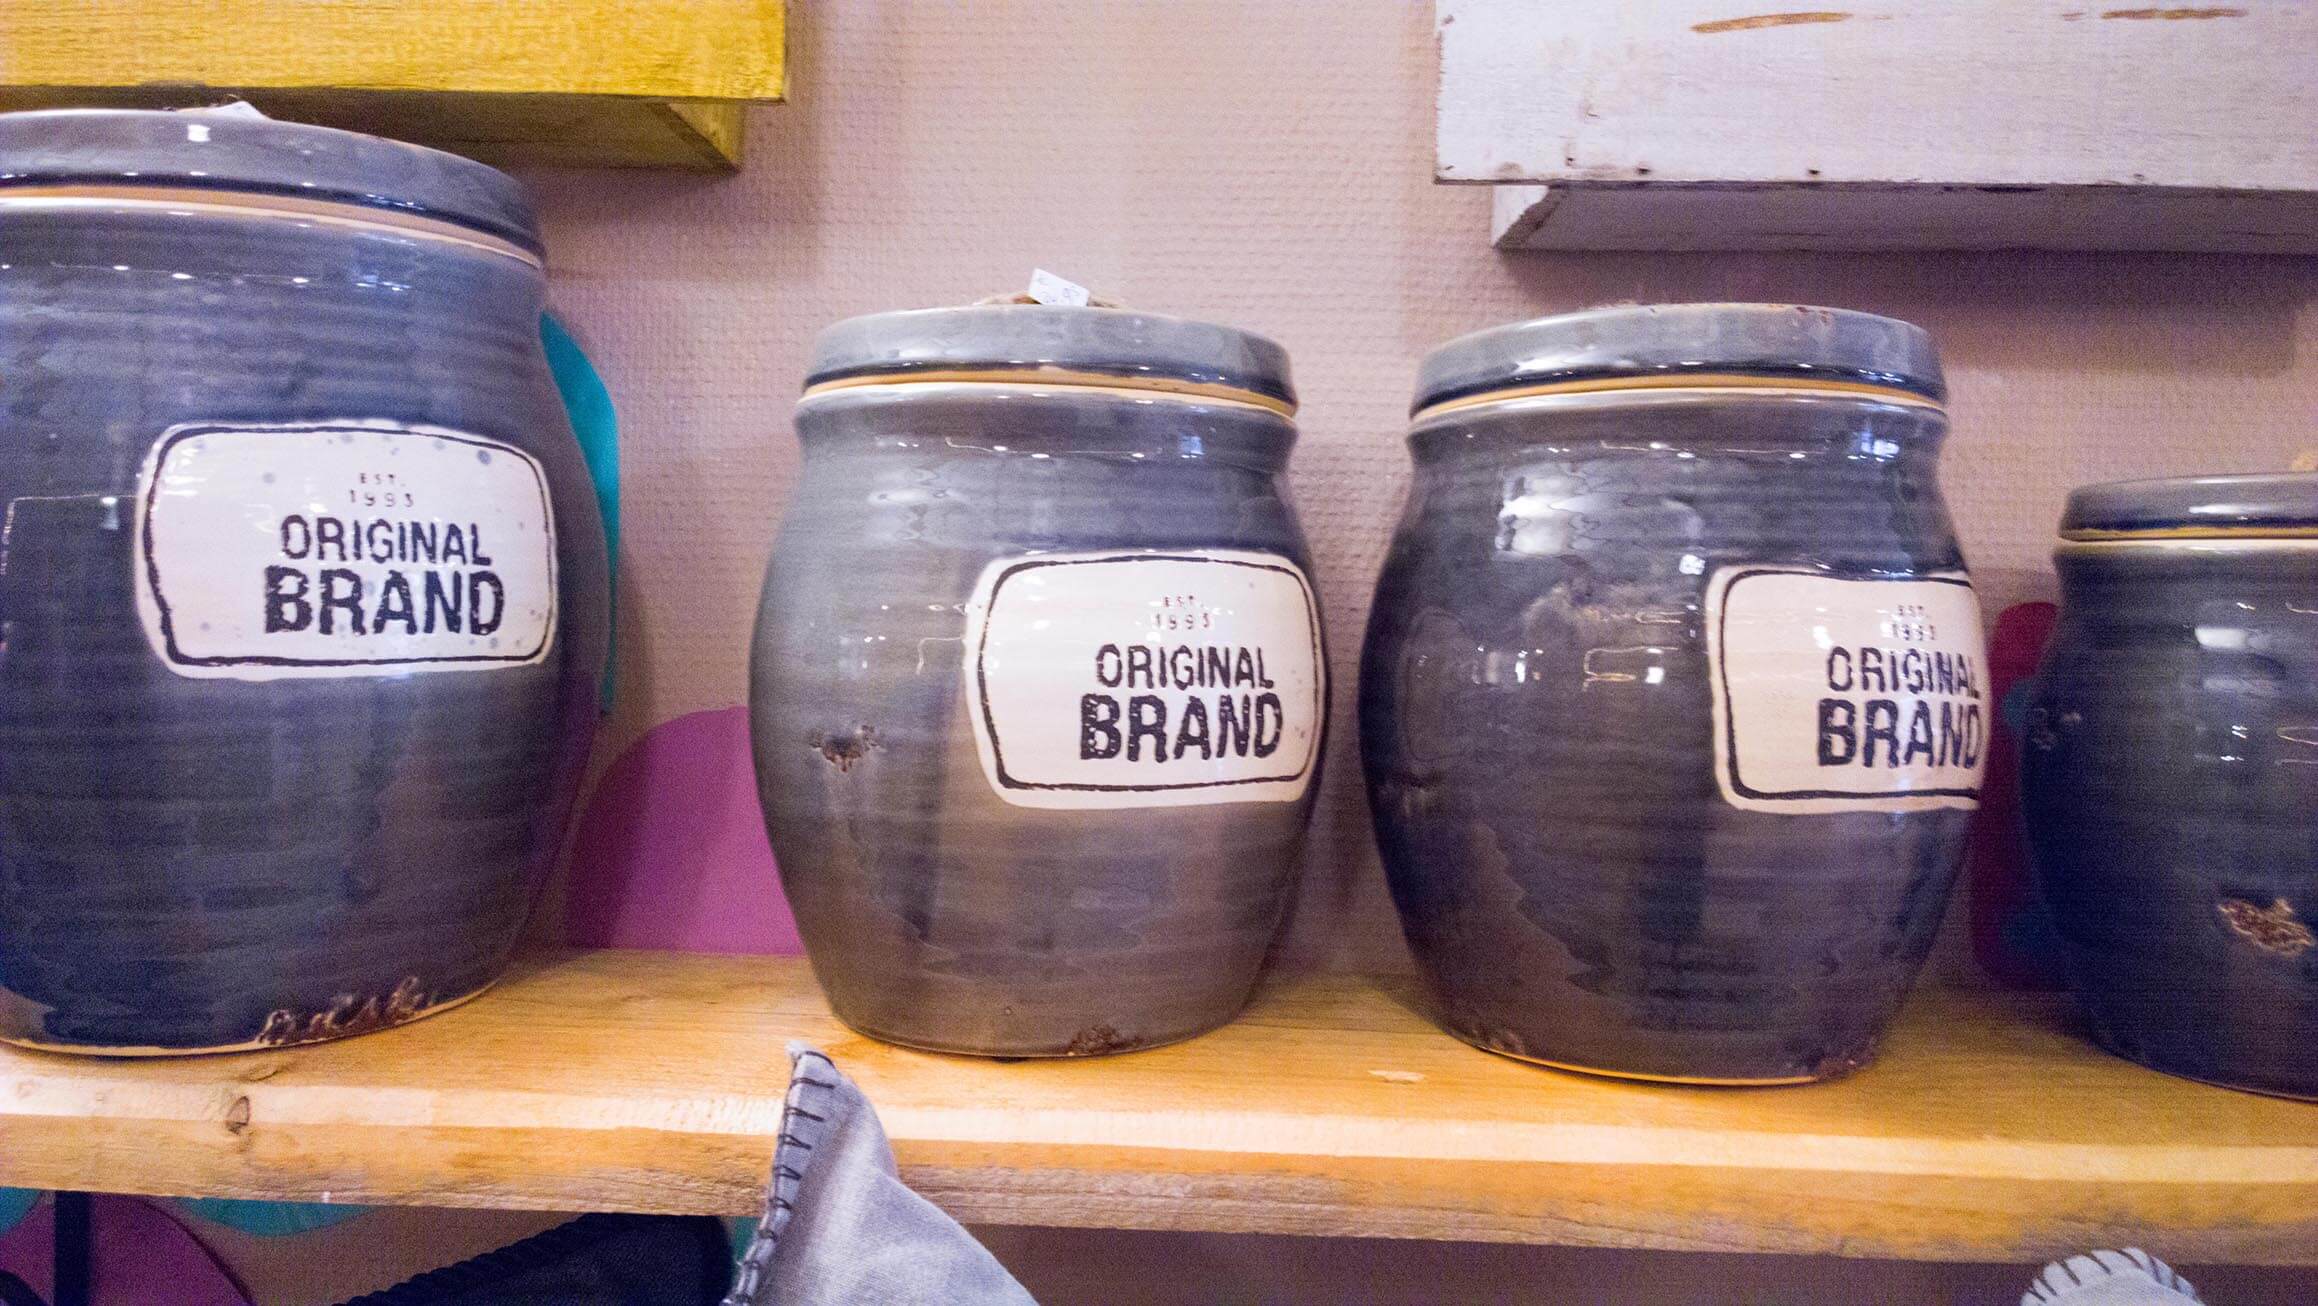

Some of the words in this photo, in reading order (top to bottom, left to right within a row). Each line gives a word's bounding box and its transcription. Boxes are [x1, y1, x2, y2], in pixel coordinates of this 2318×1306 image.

[349, 489, 415, 507] 1993
[359, 473, 407, 487] EST.
[280, 514, 493, 565] ORIGINAL
[264, 565, 504, 636] BRAND
[1154, 613, 1212, 629] 1993
[1095, 643, 1274, 691] ORIGINAL
[1827, 645, 1980, 700] ORIGINAL
[1080, 692, 1283, 762] BRAND
[1818, 698, 1982, 769] BRAND
